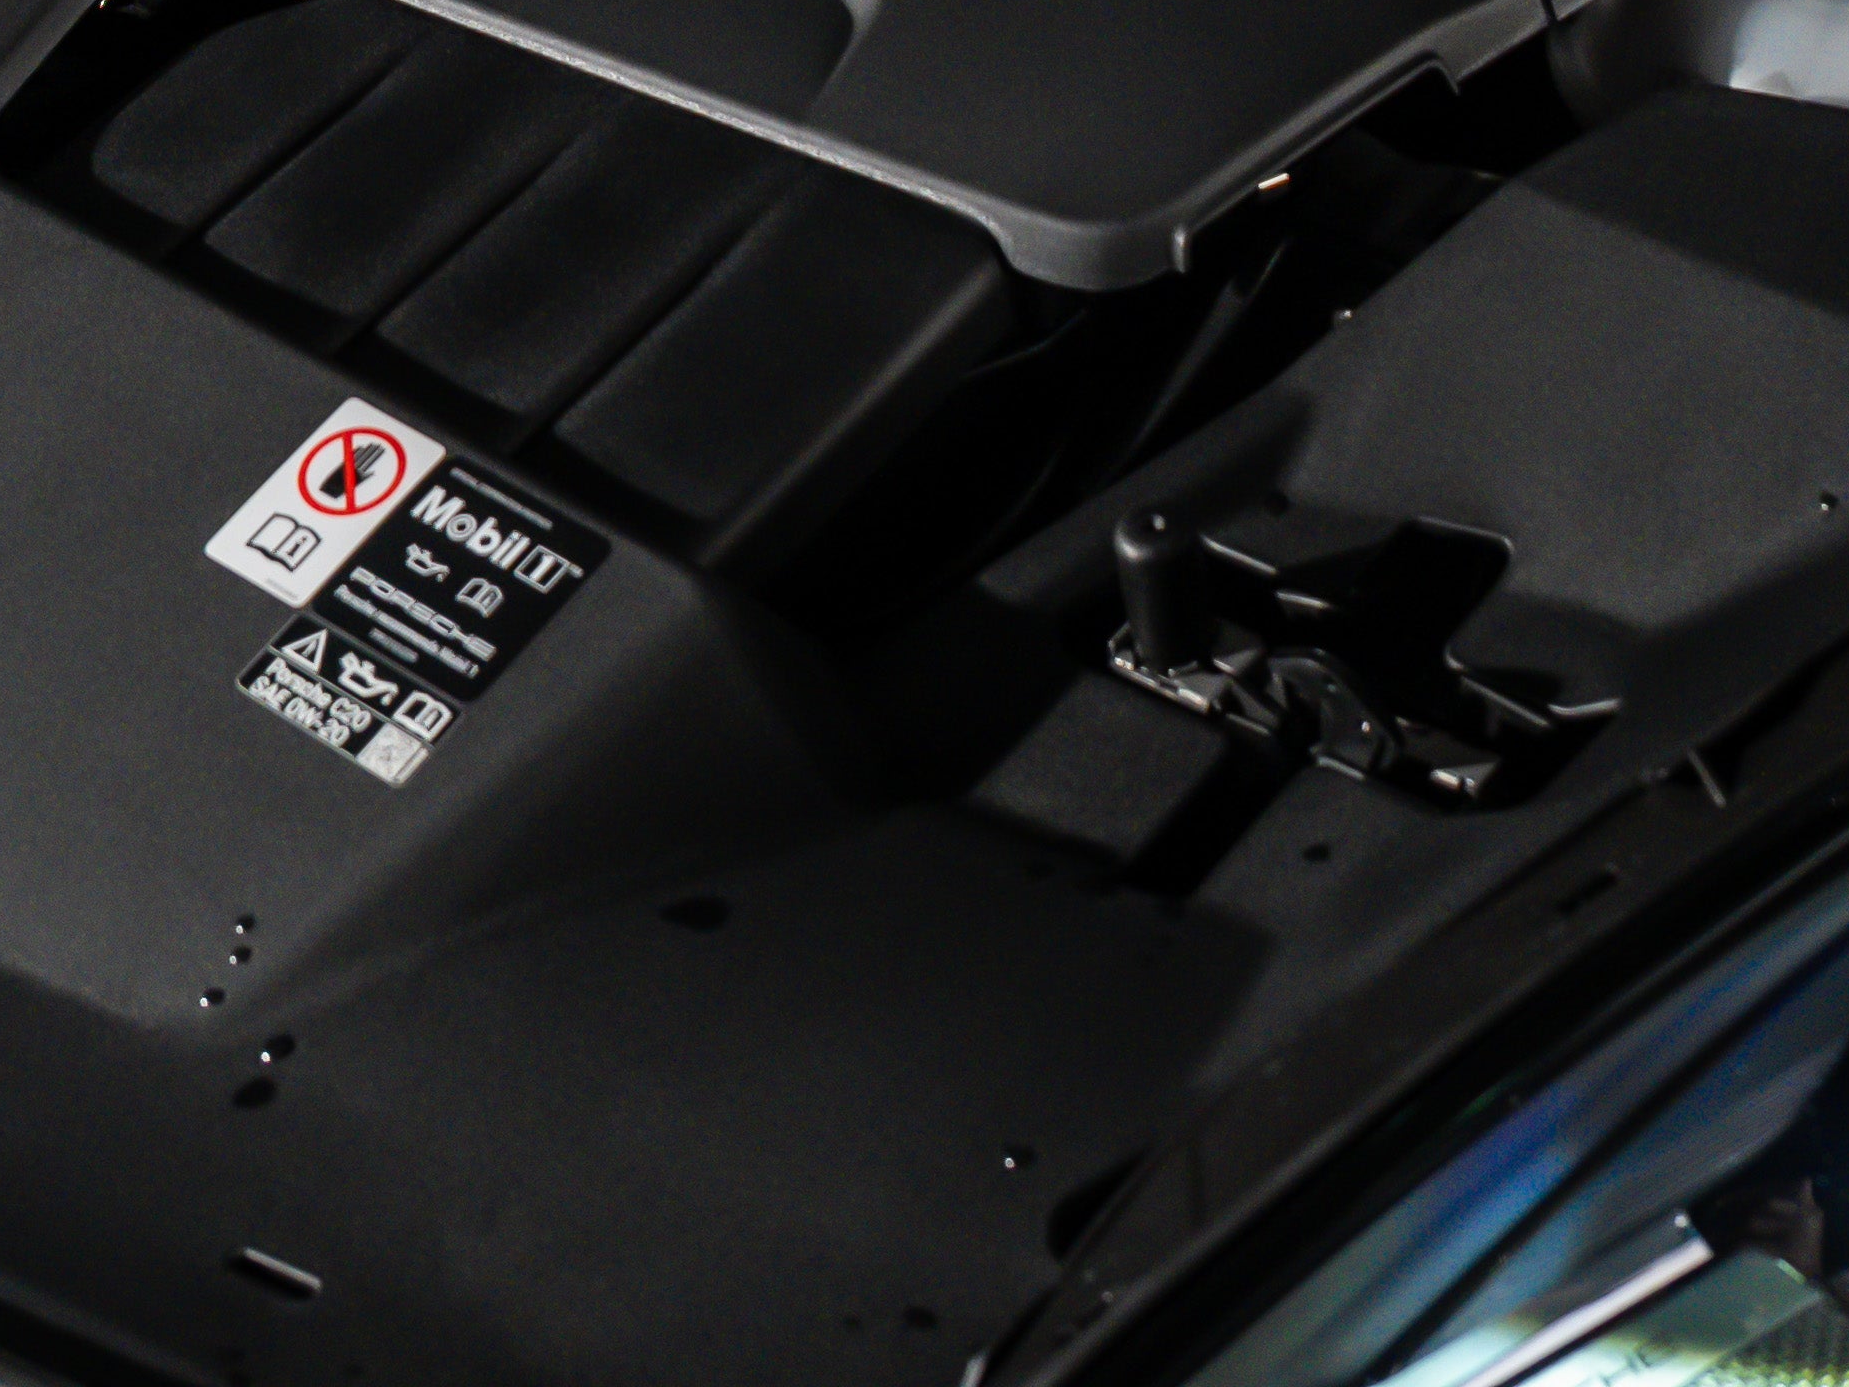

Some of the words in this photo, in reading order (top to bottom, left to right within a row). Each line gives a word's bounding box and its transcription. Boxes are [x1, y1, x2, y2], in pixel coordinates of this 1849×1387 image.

[410, 485, 531, 571] Mobil
[349, 565, 497, 661] PORSCHE
[247, 674, 291, 712] SAE
[282, 697, 351, 746] 0W-20
[265, 656, 333, 709] Porsche
[328, 695, 373, 733] C20
